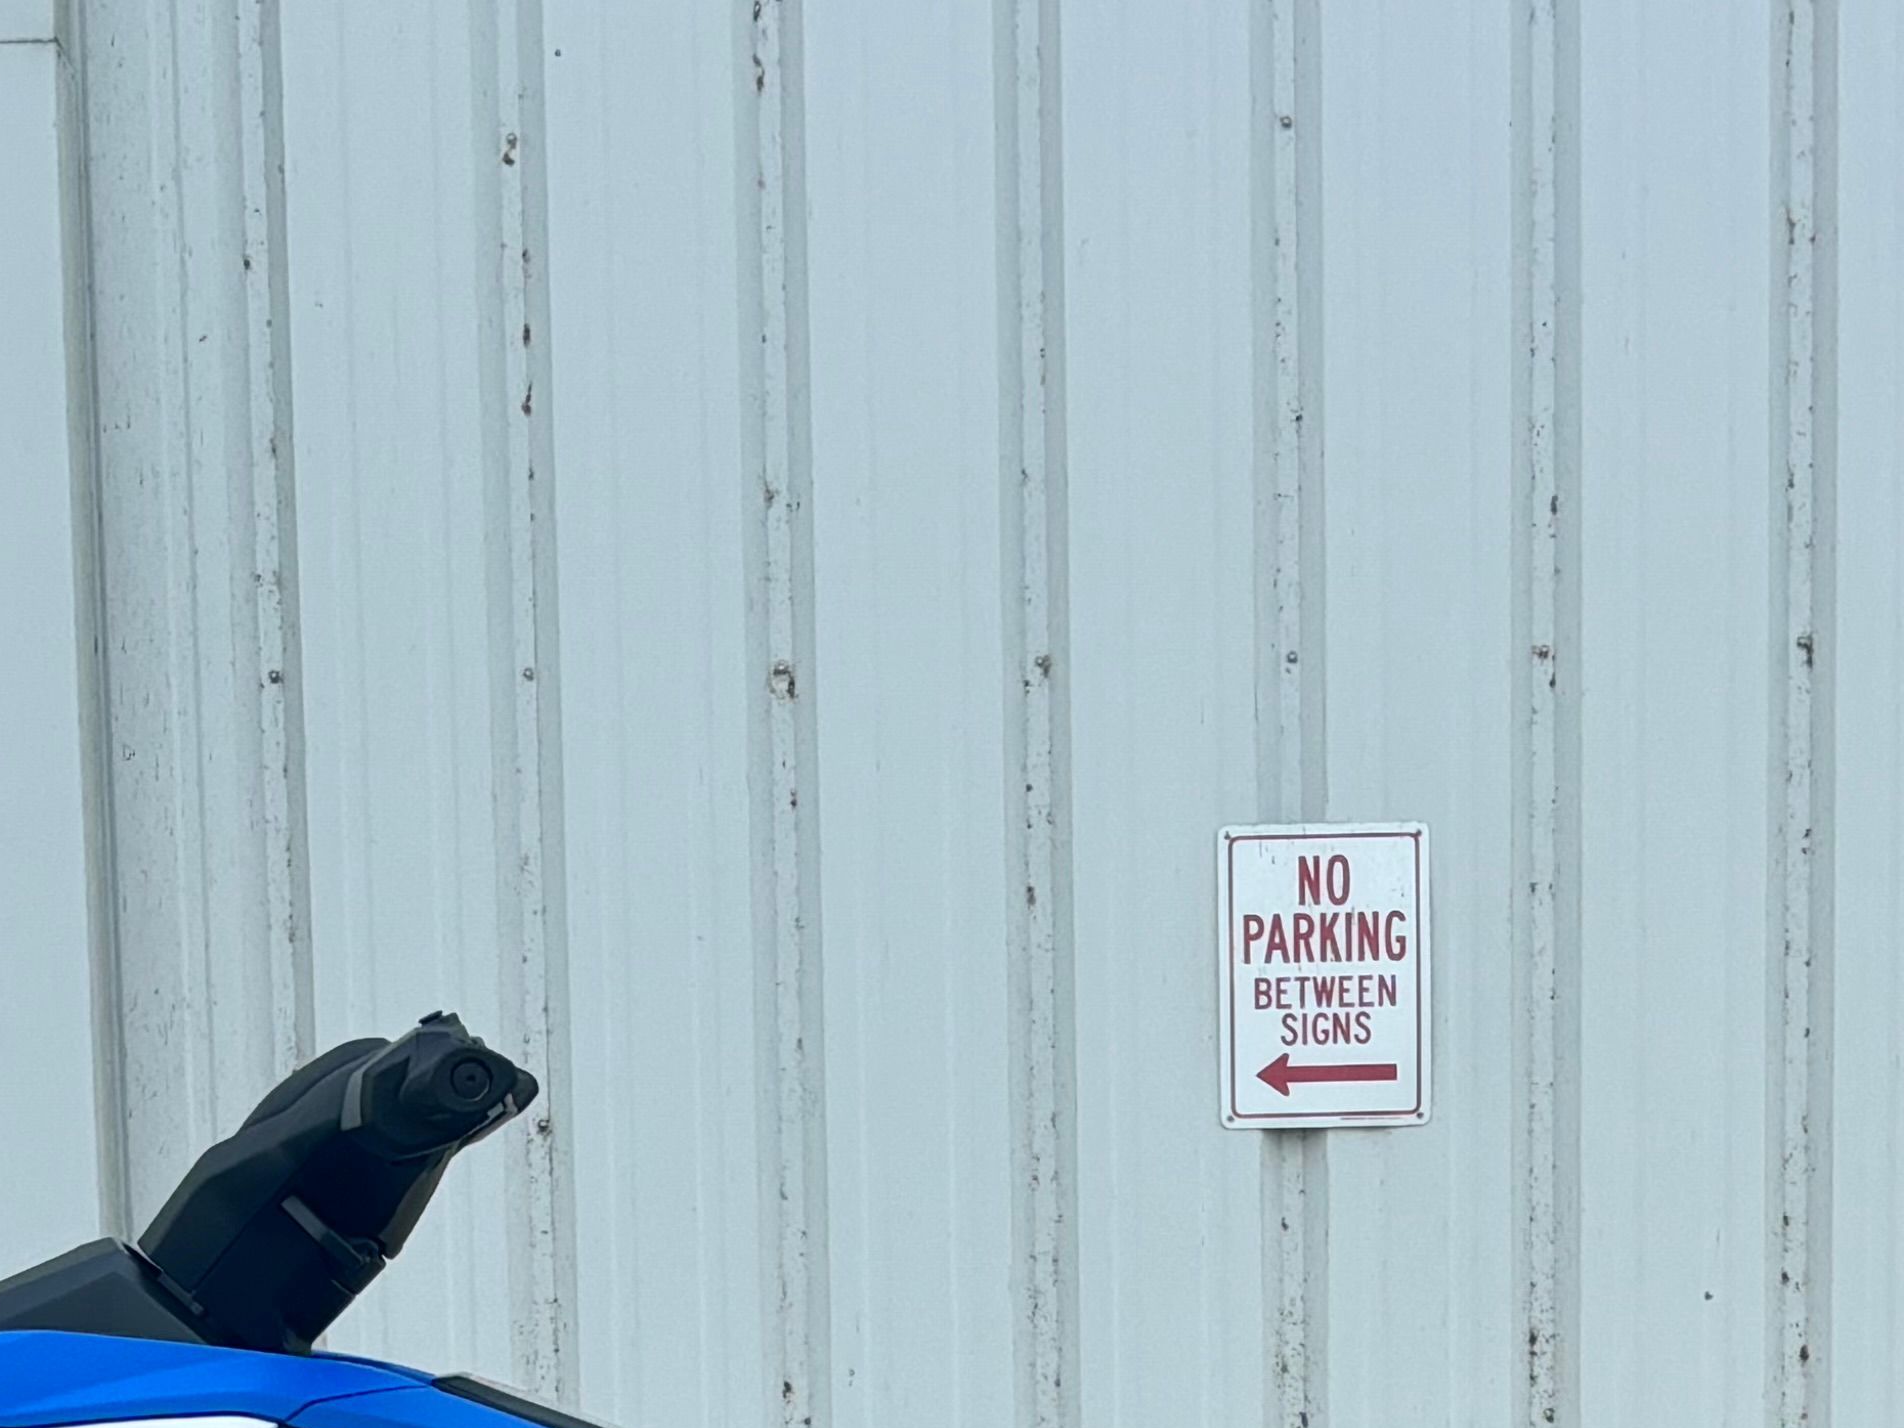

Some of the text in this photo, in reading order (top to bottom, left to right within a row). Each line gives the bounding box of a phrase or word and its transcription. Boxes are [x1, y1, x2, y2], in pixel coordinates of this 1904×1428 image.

[1298, 854, 1350, 906] NO
[1243, 911, 1406, 964] PARKING
[1254, 974, 1397, 1010] BETWEEN
[1280, 1011, 1371, 1046] SIGNS
